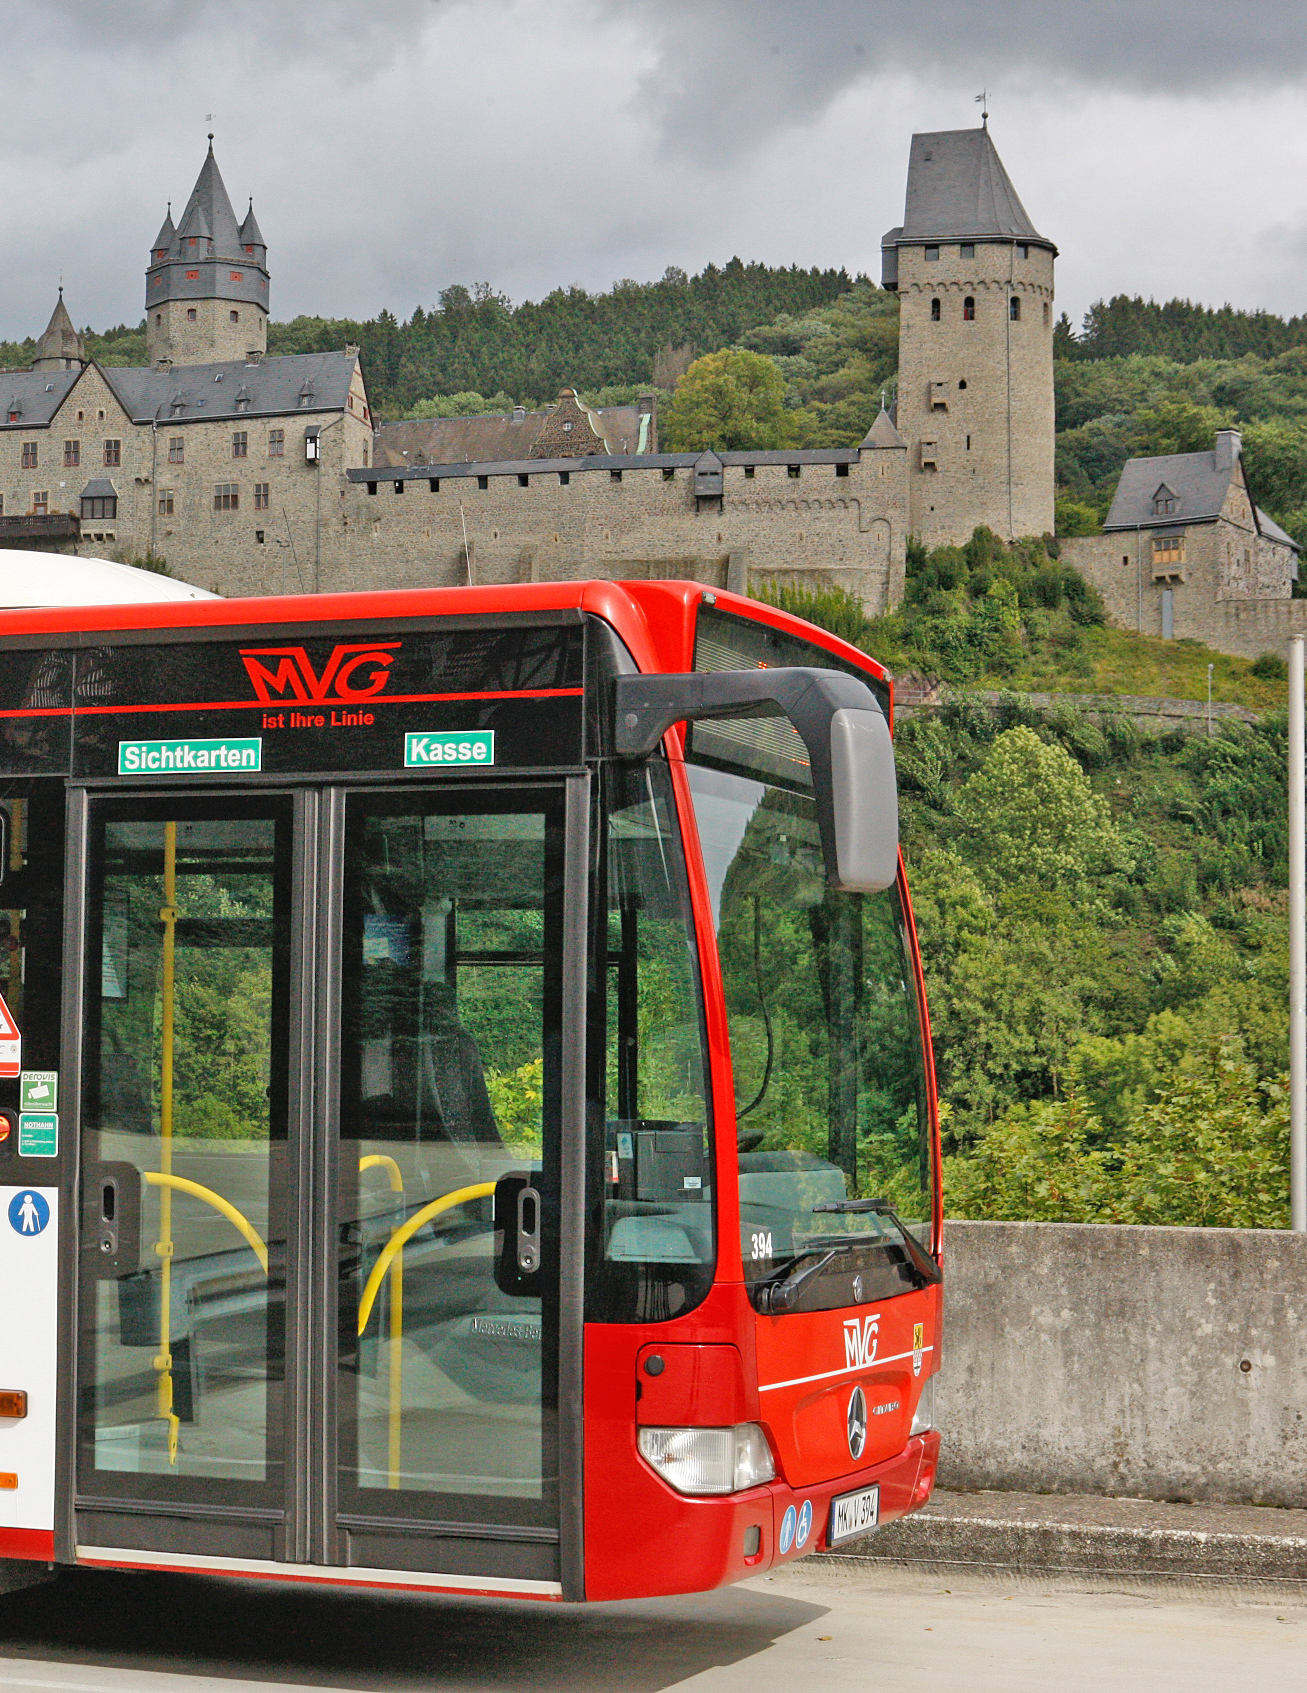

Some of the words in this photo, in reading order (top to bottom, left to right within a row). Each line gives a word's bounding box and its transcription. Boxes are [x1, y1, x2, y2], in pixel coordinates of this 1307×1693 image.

[238, 641, 402, 700] MVG
[262, 713, 285, 729] ist
[290, 712, 325, 728] Ihre
[330, 710, 375, 727] Linie
[123, 743, 256, 770] Sichtkarten
[410, 736, 487, 763] Kasse
[751, 1232, 773, 1260] 394
[842, 1313, 881, 1369] MVG
[860, 1493, 875, 1525] 394
